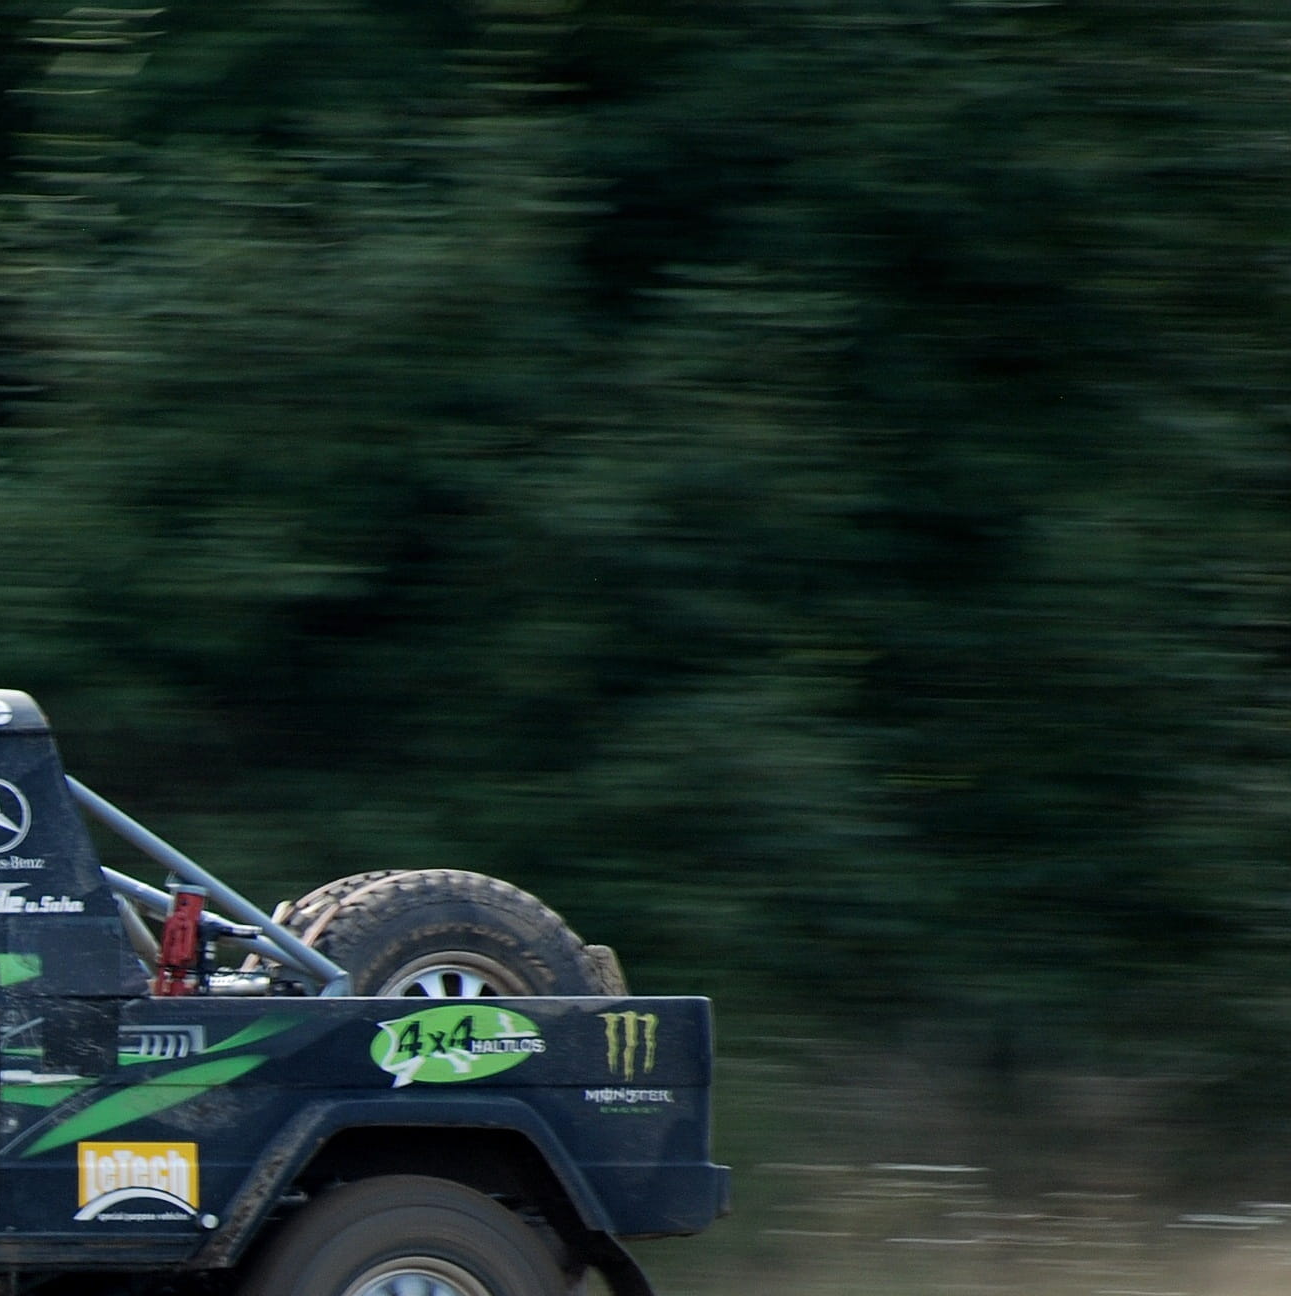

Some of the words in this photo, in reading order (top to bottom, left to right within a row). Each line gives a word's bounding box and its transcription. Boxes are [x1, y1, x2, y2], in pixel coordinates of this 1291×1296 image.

[396, 1015, 475, 1059] 4x4
[471, 1038, 546, 1053] HALTLOS
[585, 1087, 675, 1103] MONSTER
